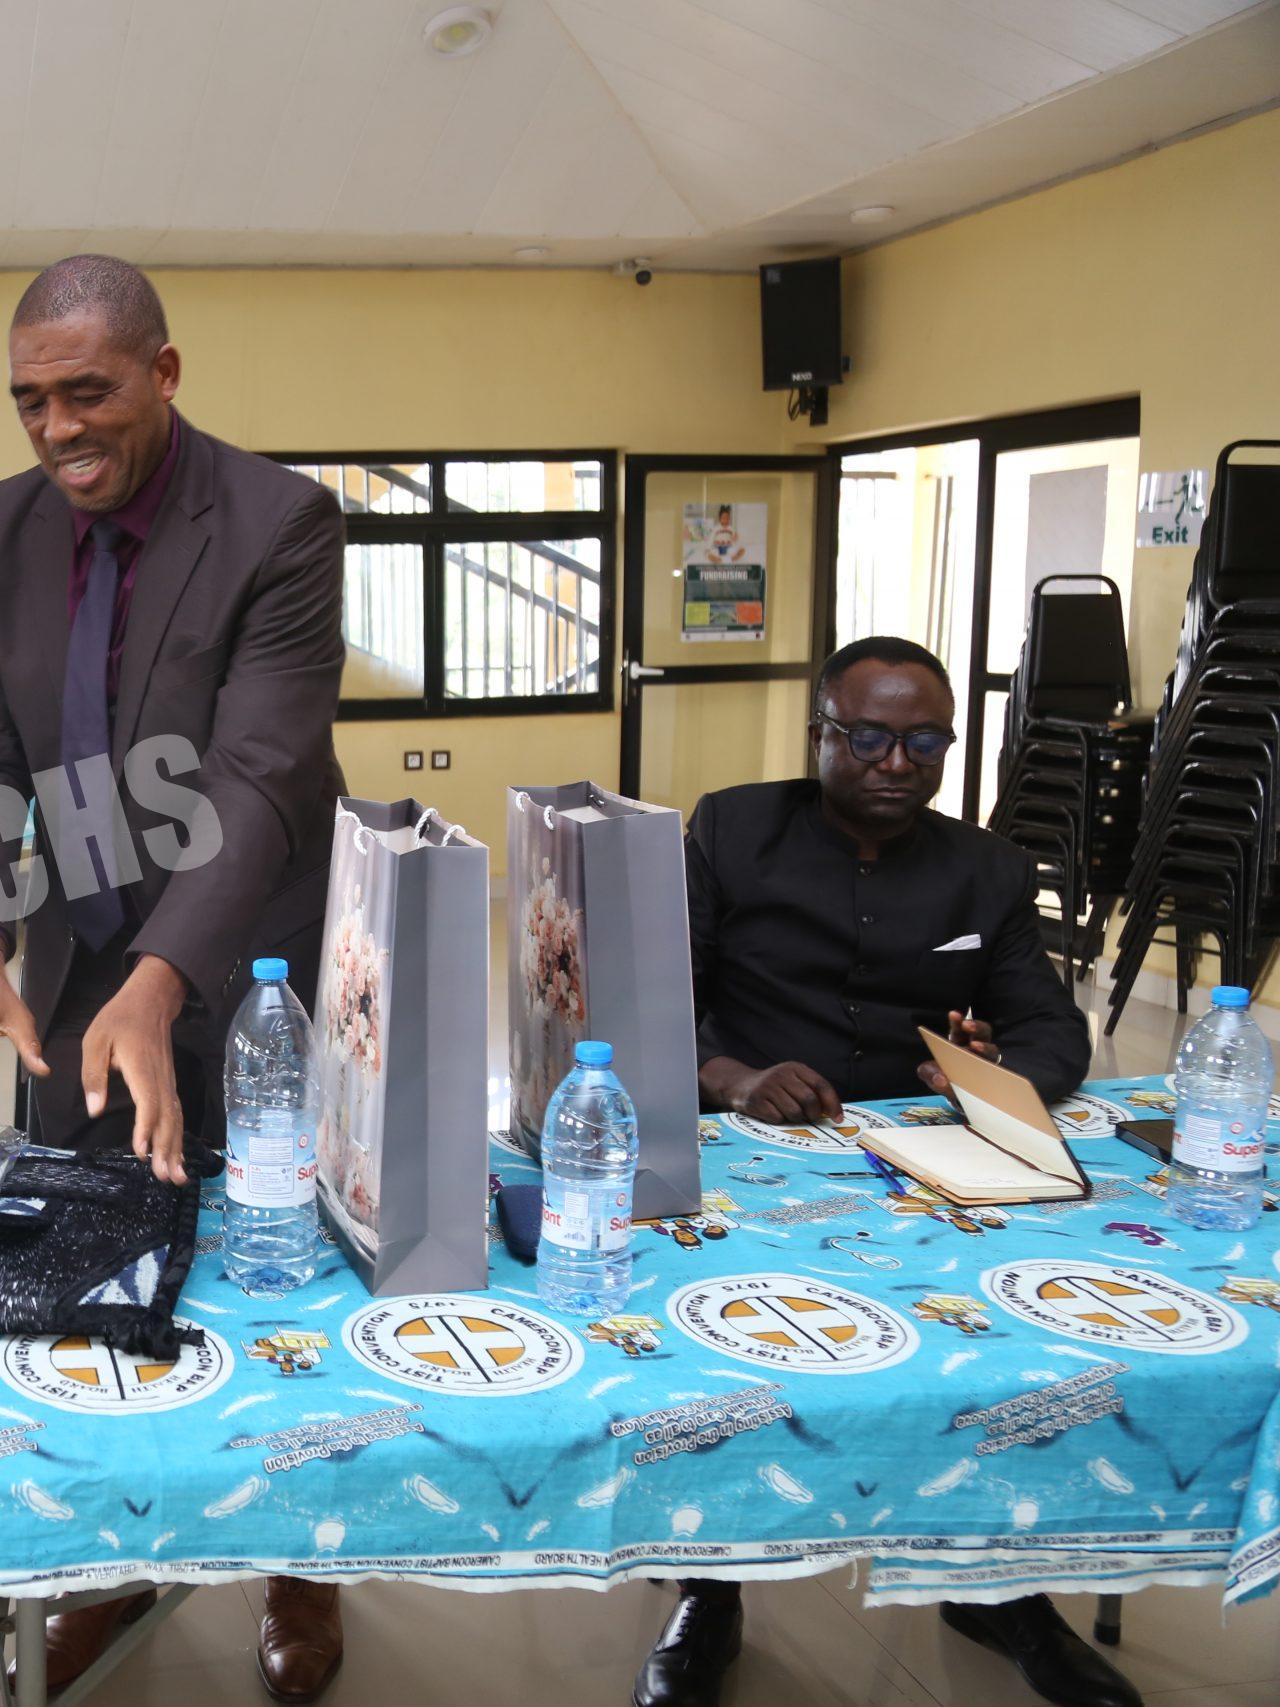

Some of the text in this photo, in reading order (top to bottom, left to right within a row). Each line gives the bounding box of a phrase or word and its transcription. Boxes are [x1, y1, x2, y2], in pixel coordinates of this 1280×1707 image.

[1152, 526, 1189, 544] Exit
[722, 1281, 770, 1291] 1975
[1112, 1269, 1215, 1315] CAMEROON
[1001, 1272, 1069, 1327] CONVENTION
[806, 1287, 897, 1333] CAMEROON
[685, 1293, 740, 1346] CONVENTION
[1075, 1327, 1128, 1341] TIST
[361, 1308, 561, 1383] CAMEROON BAP TIST CONVENTION
[740, 1347, 790, 1362] TIST
[59, 1379, 108, 1393] BOARD
[175, 1372, 203, 1392] BAP
[36, 1383, 78, 1399] TIST
[697, 1408, 726, 1425] Care
[612, 1419, 644, 1437] Love
[634, 1403, 791, 1465] Assisting in the Provision
[662, 1424, 681, 1441] all
[287, 1437, 307, 1449] all
[646, 1430, 662, 1444] as
[264, 1423, 424, 1474] Assisting in the Provision
[270, 1441, 287, 1450] as
[647, 1546, 681, 1556] BAPTIST
[684, 1547, 732, 1557] CAMEROON
[764, 1544, 792, 1555] BOARD
[417, 1558, 450, 1568] BAPTIST
[452, 1556, 500, 1567] CAMEROON
[535, 1554, 565, 1564] BOARD
[568, 1554, 602, 1566] HEALTH
[288, 1562, 319, 1571] BOARD
